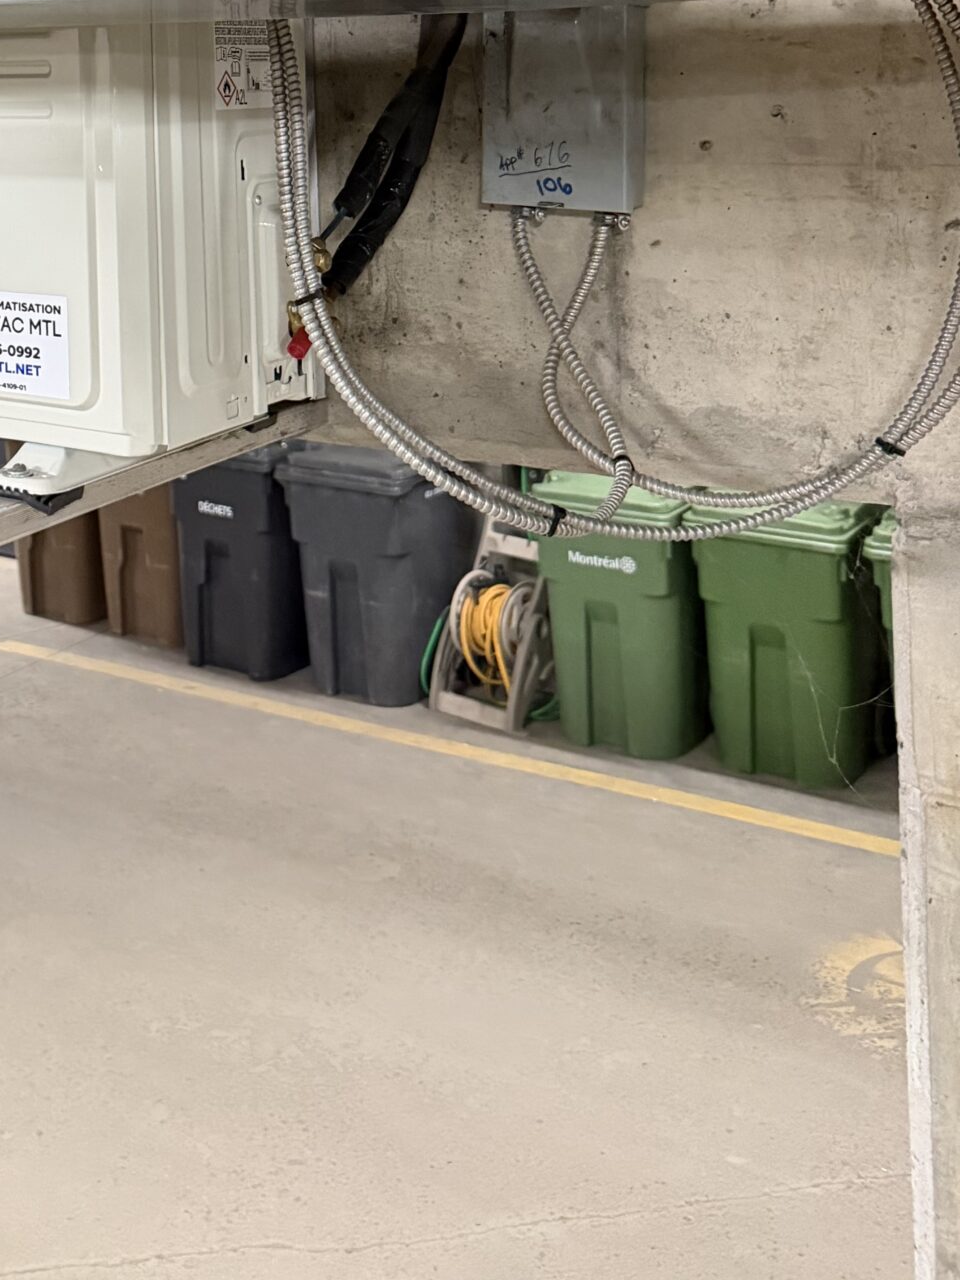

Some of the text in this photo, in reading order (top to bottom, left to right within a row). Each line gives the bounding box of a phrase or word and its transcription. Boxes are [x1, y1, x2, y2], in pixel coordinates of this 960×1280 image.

[536, 176, 573, 196] 106
[29, 318, 62, 338] MTL
[567, 549, 620, 570] Montréal
